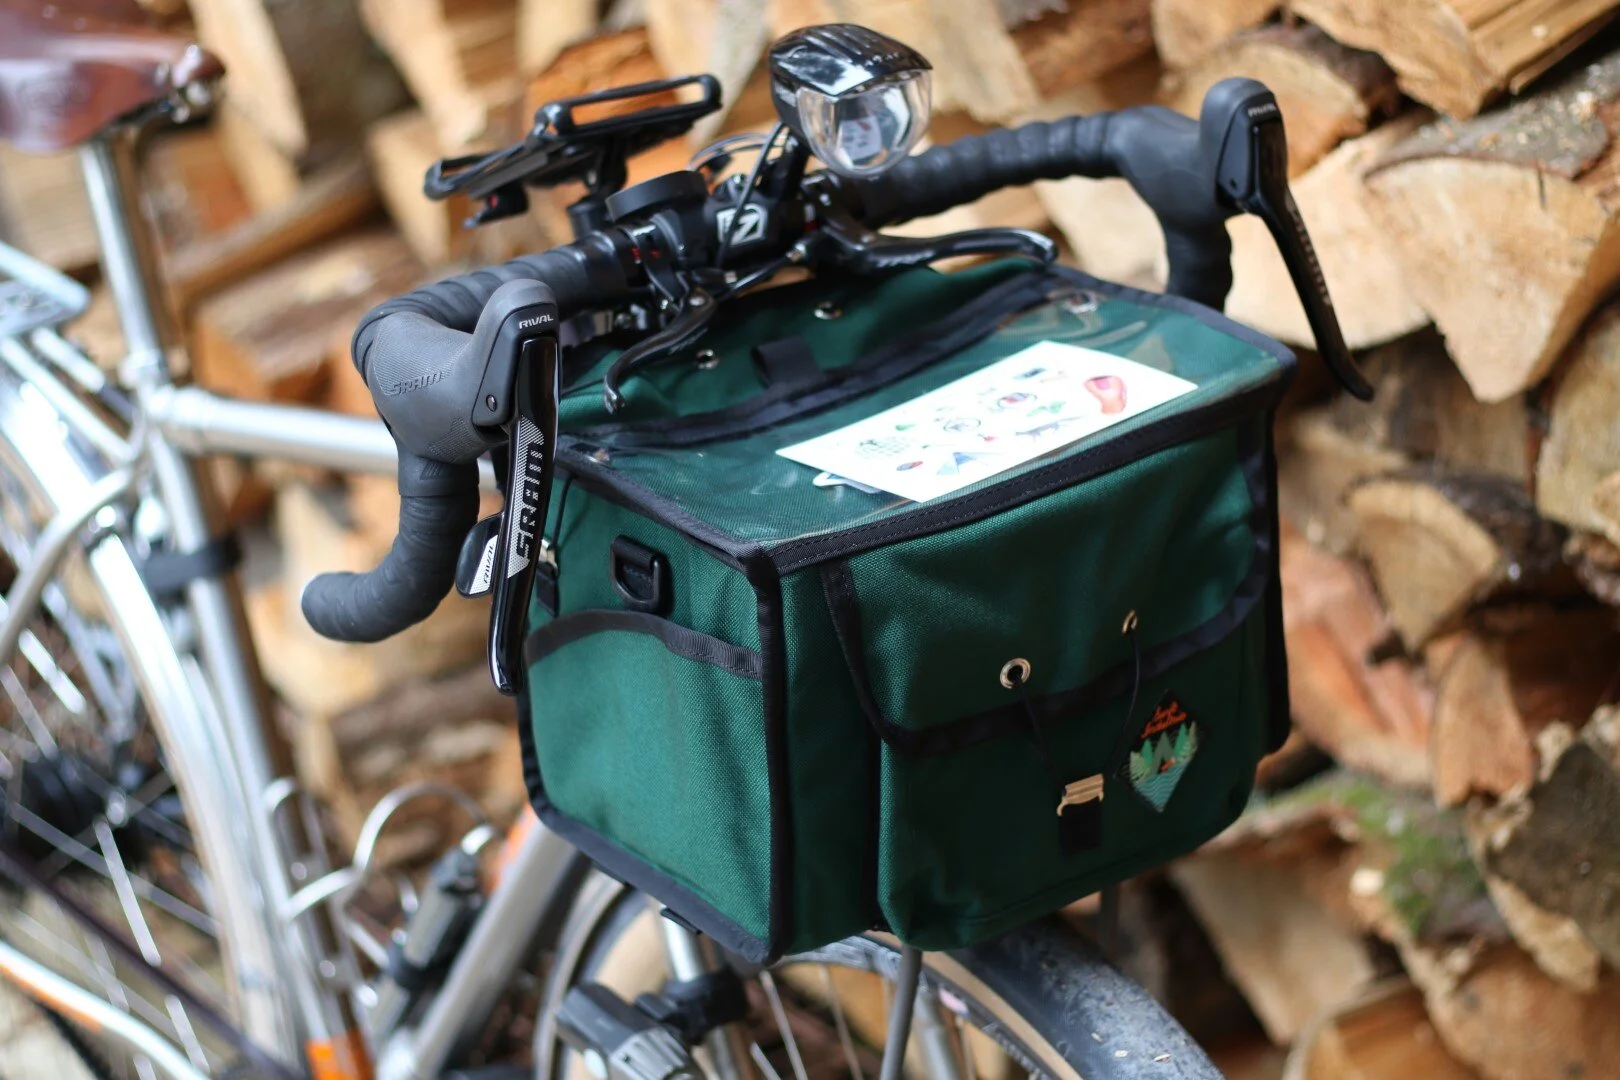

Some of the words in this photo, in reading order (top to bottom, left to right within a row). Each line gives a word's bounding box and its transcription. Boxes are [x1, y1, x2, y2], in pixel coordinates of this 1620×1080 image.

[519, 314, 554, 330] RIVAL
[389, 371, 443, 397] SRAM
[516, 441, 544, 559] SRAM
[484, 545, 495, 584] RIVAL
